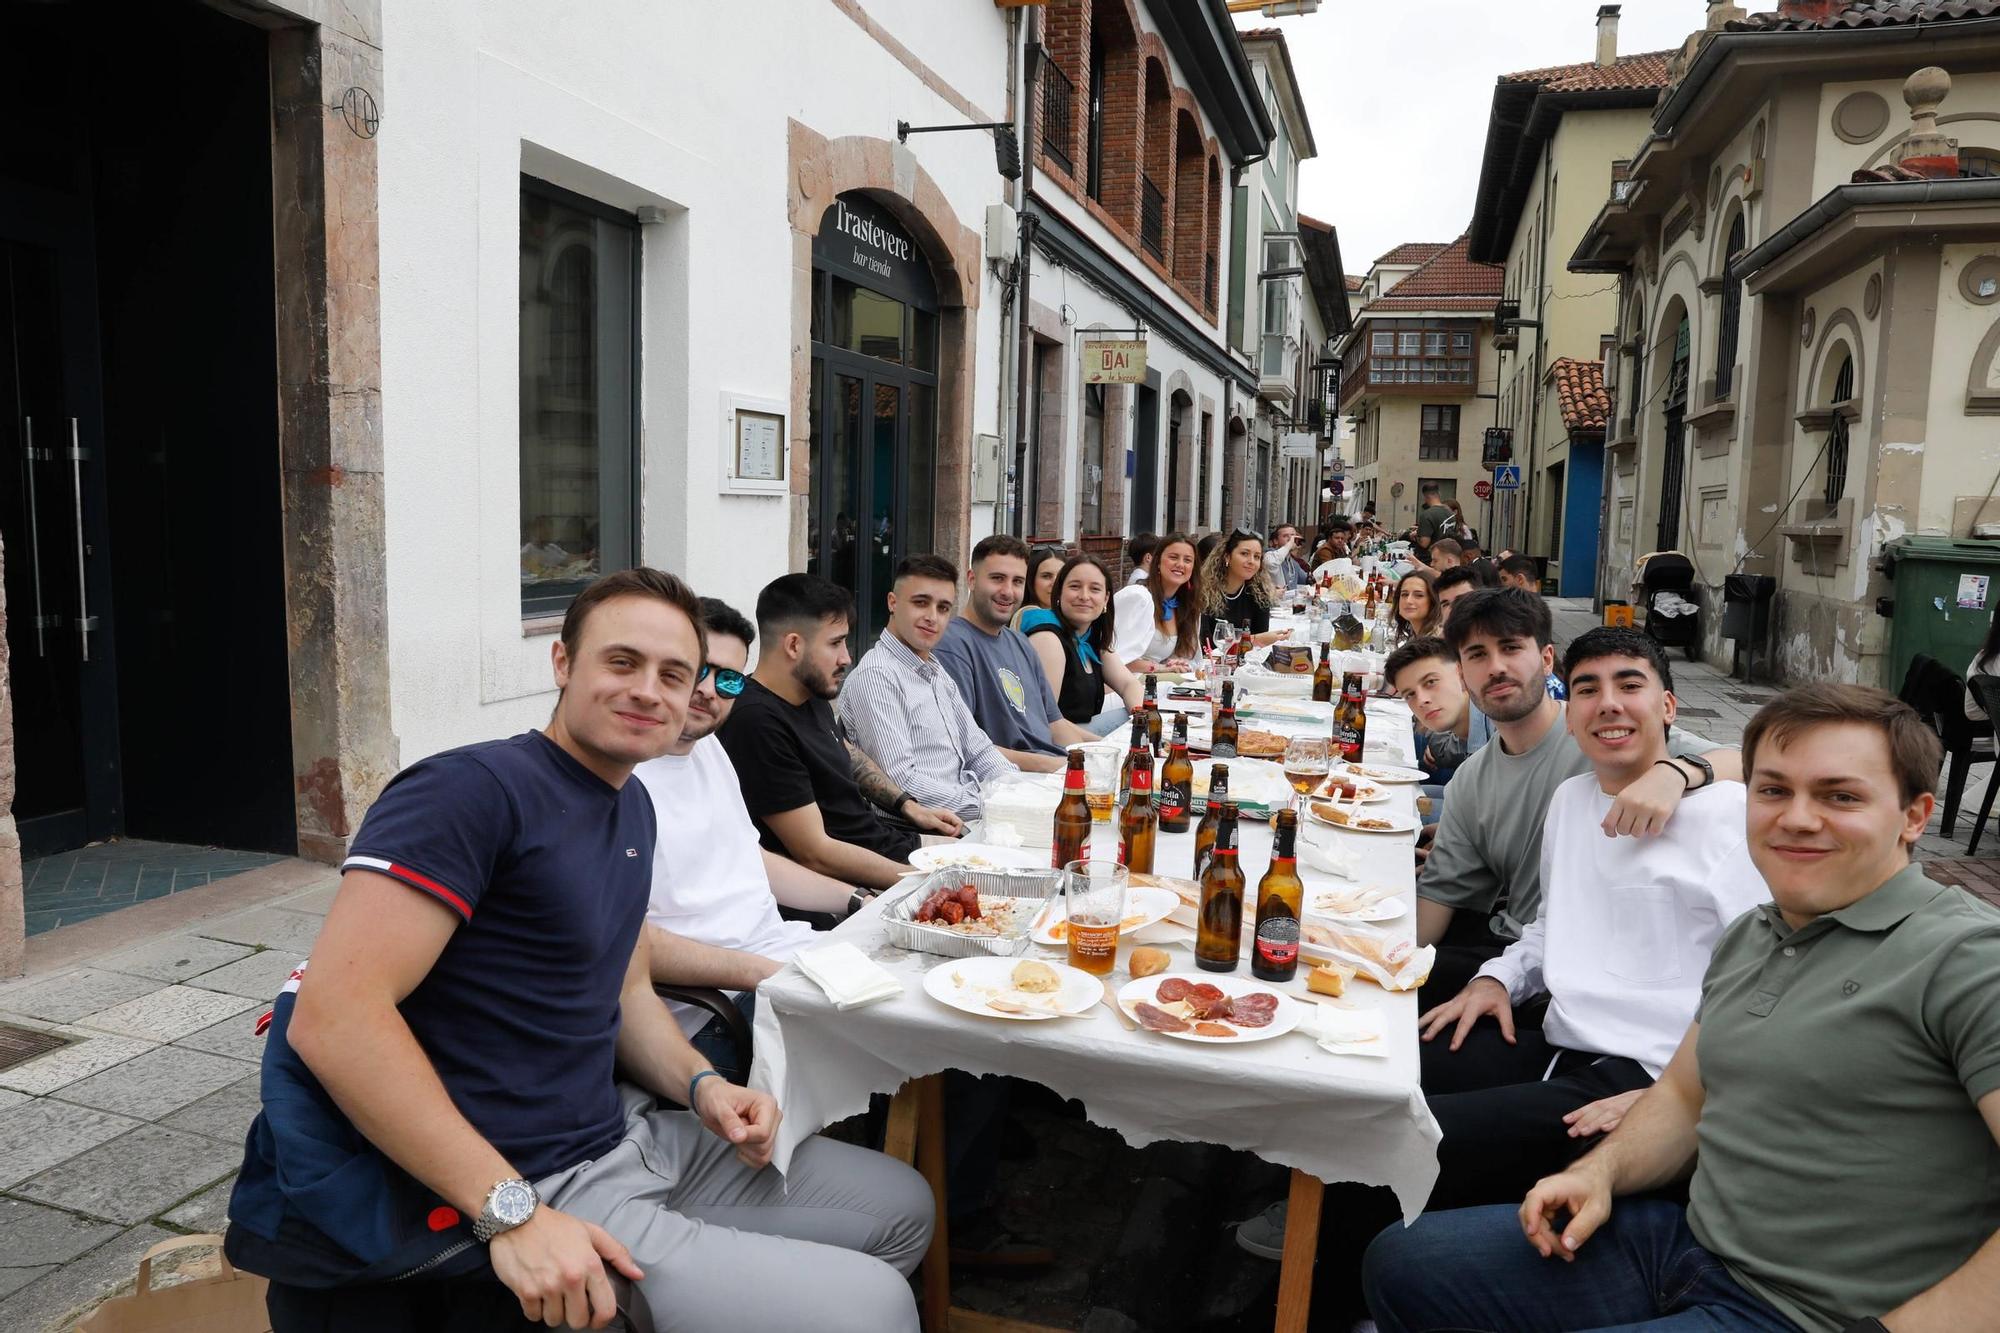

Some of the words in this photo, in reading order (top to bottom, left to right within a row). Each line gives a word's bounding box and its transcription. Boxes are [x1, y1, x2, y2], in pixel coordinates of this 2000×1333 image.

[836, 199, 908, 261] Trastevere
[853, 245, 868, 267] bar
[868, 256, 891, 278] tienda
[1474, 484, 1491, 494] STOP
